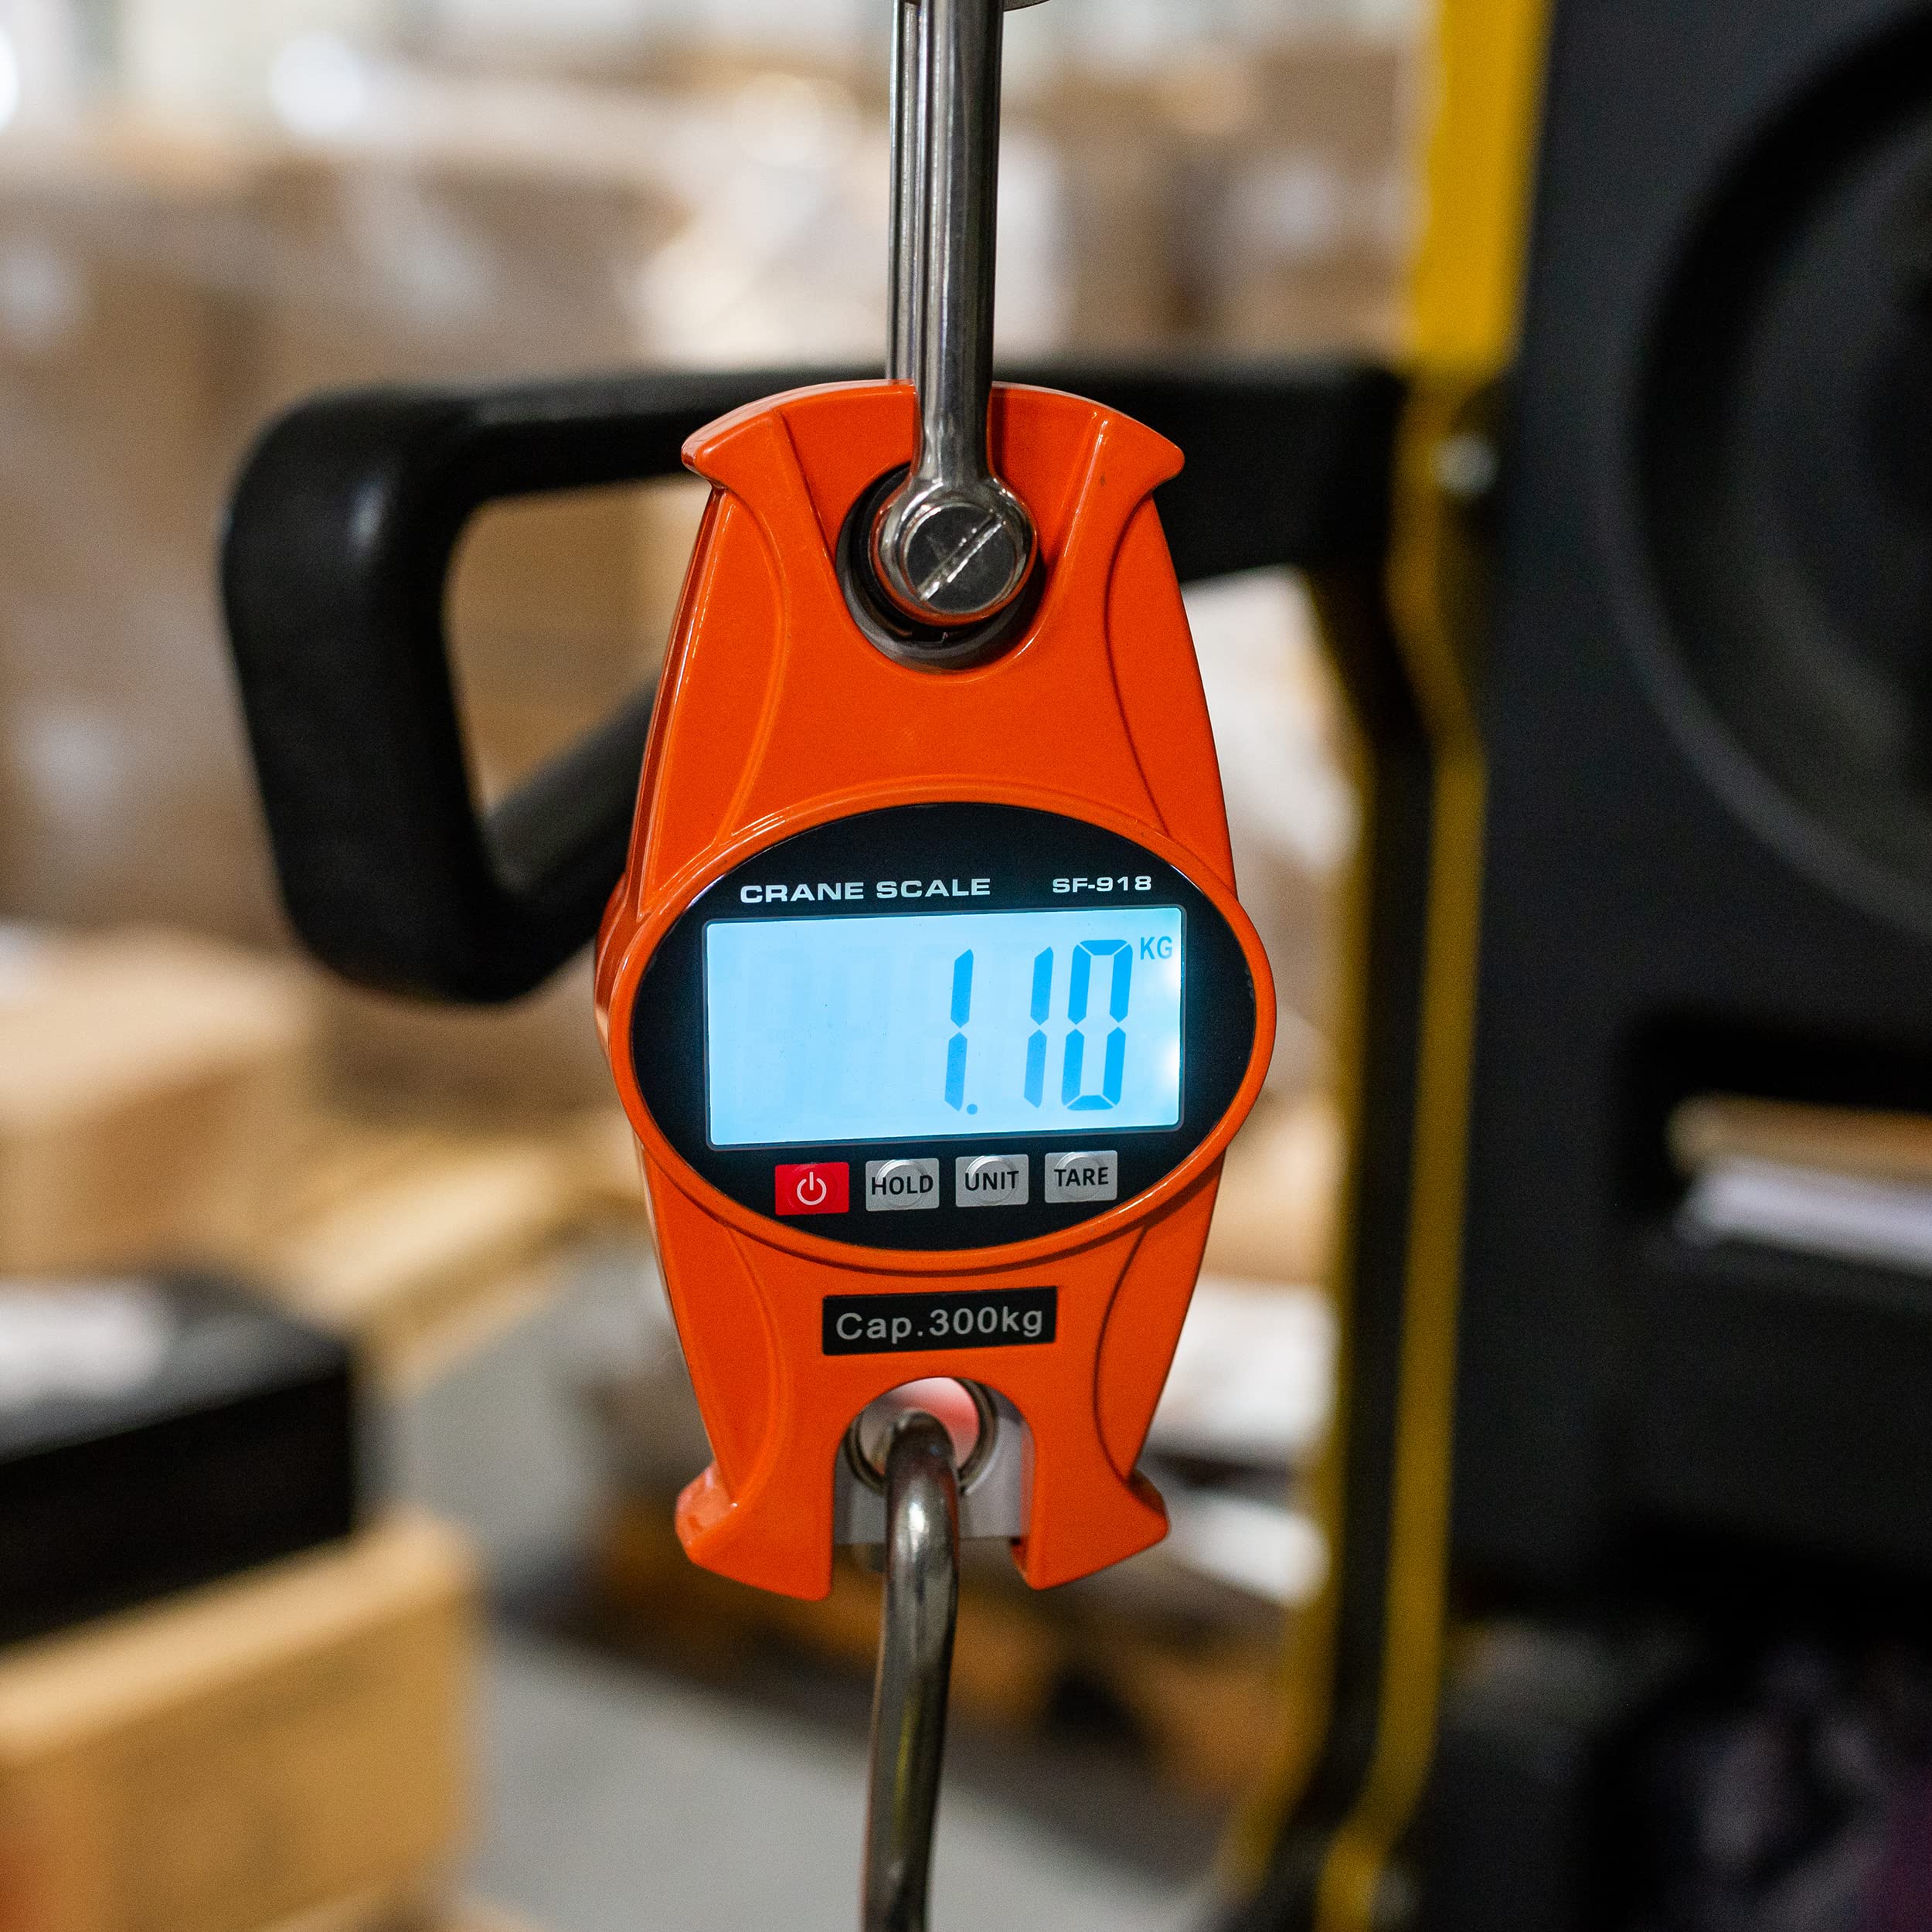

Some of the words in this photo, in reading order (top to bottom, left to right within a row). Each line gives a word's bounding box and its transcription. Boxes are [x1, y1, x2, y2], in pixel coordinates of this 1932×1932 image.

[740, 881, 864, 903] CRANE
[876, 878, 991, 899] SCALE
[1052, 876, 1151, 893] SF-918
[944, 939, 1133, 1115] 1.10
[1140, 936, 1173, 960] KG
[872, 1174, 934, 1196] HOLD
[964, 1170, 1019, 1192] UNIT
[1053, 1166, 1109, 1187] TARE
[835, 1306, 1043, 1344] Cap.300kg
